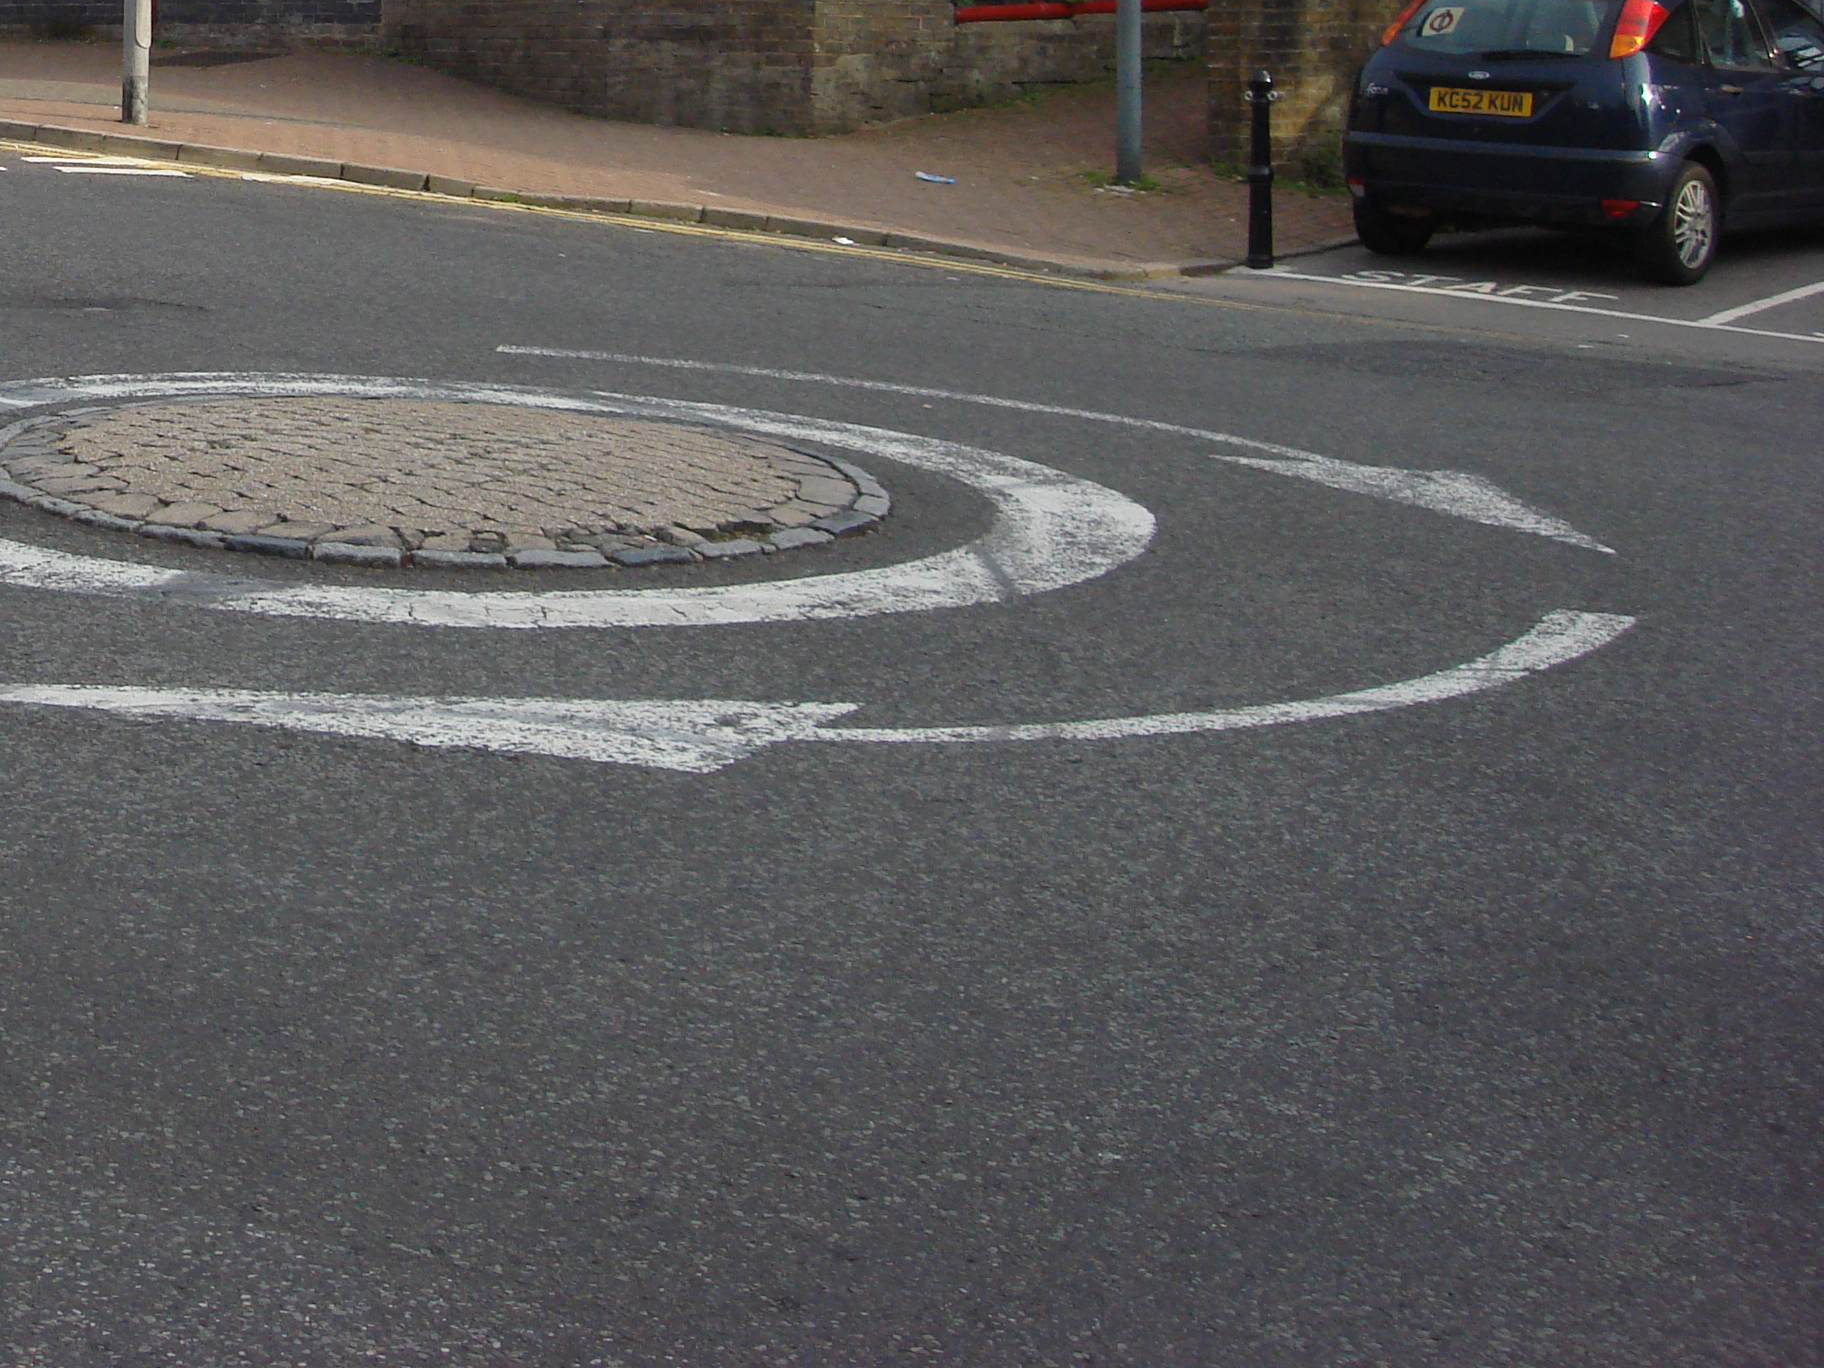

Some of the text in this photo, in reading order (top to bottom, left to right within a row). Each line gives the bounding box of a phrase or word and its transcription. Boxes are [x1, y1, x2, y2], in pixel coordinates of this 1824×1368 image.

[1437, 93, 1524, 112] KC52 KUN
[1341, 270, 1619, 302] STAFF
